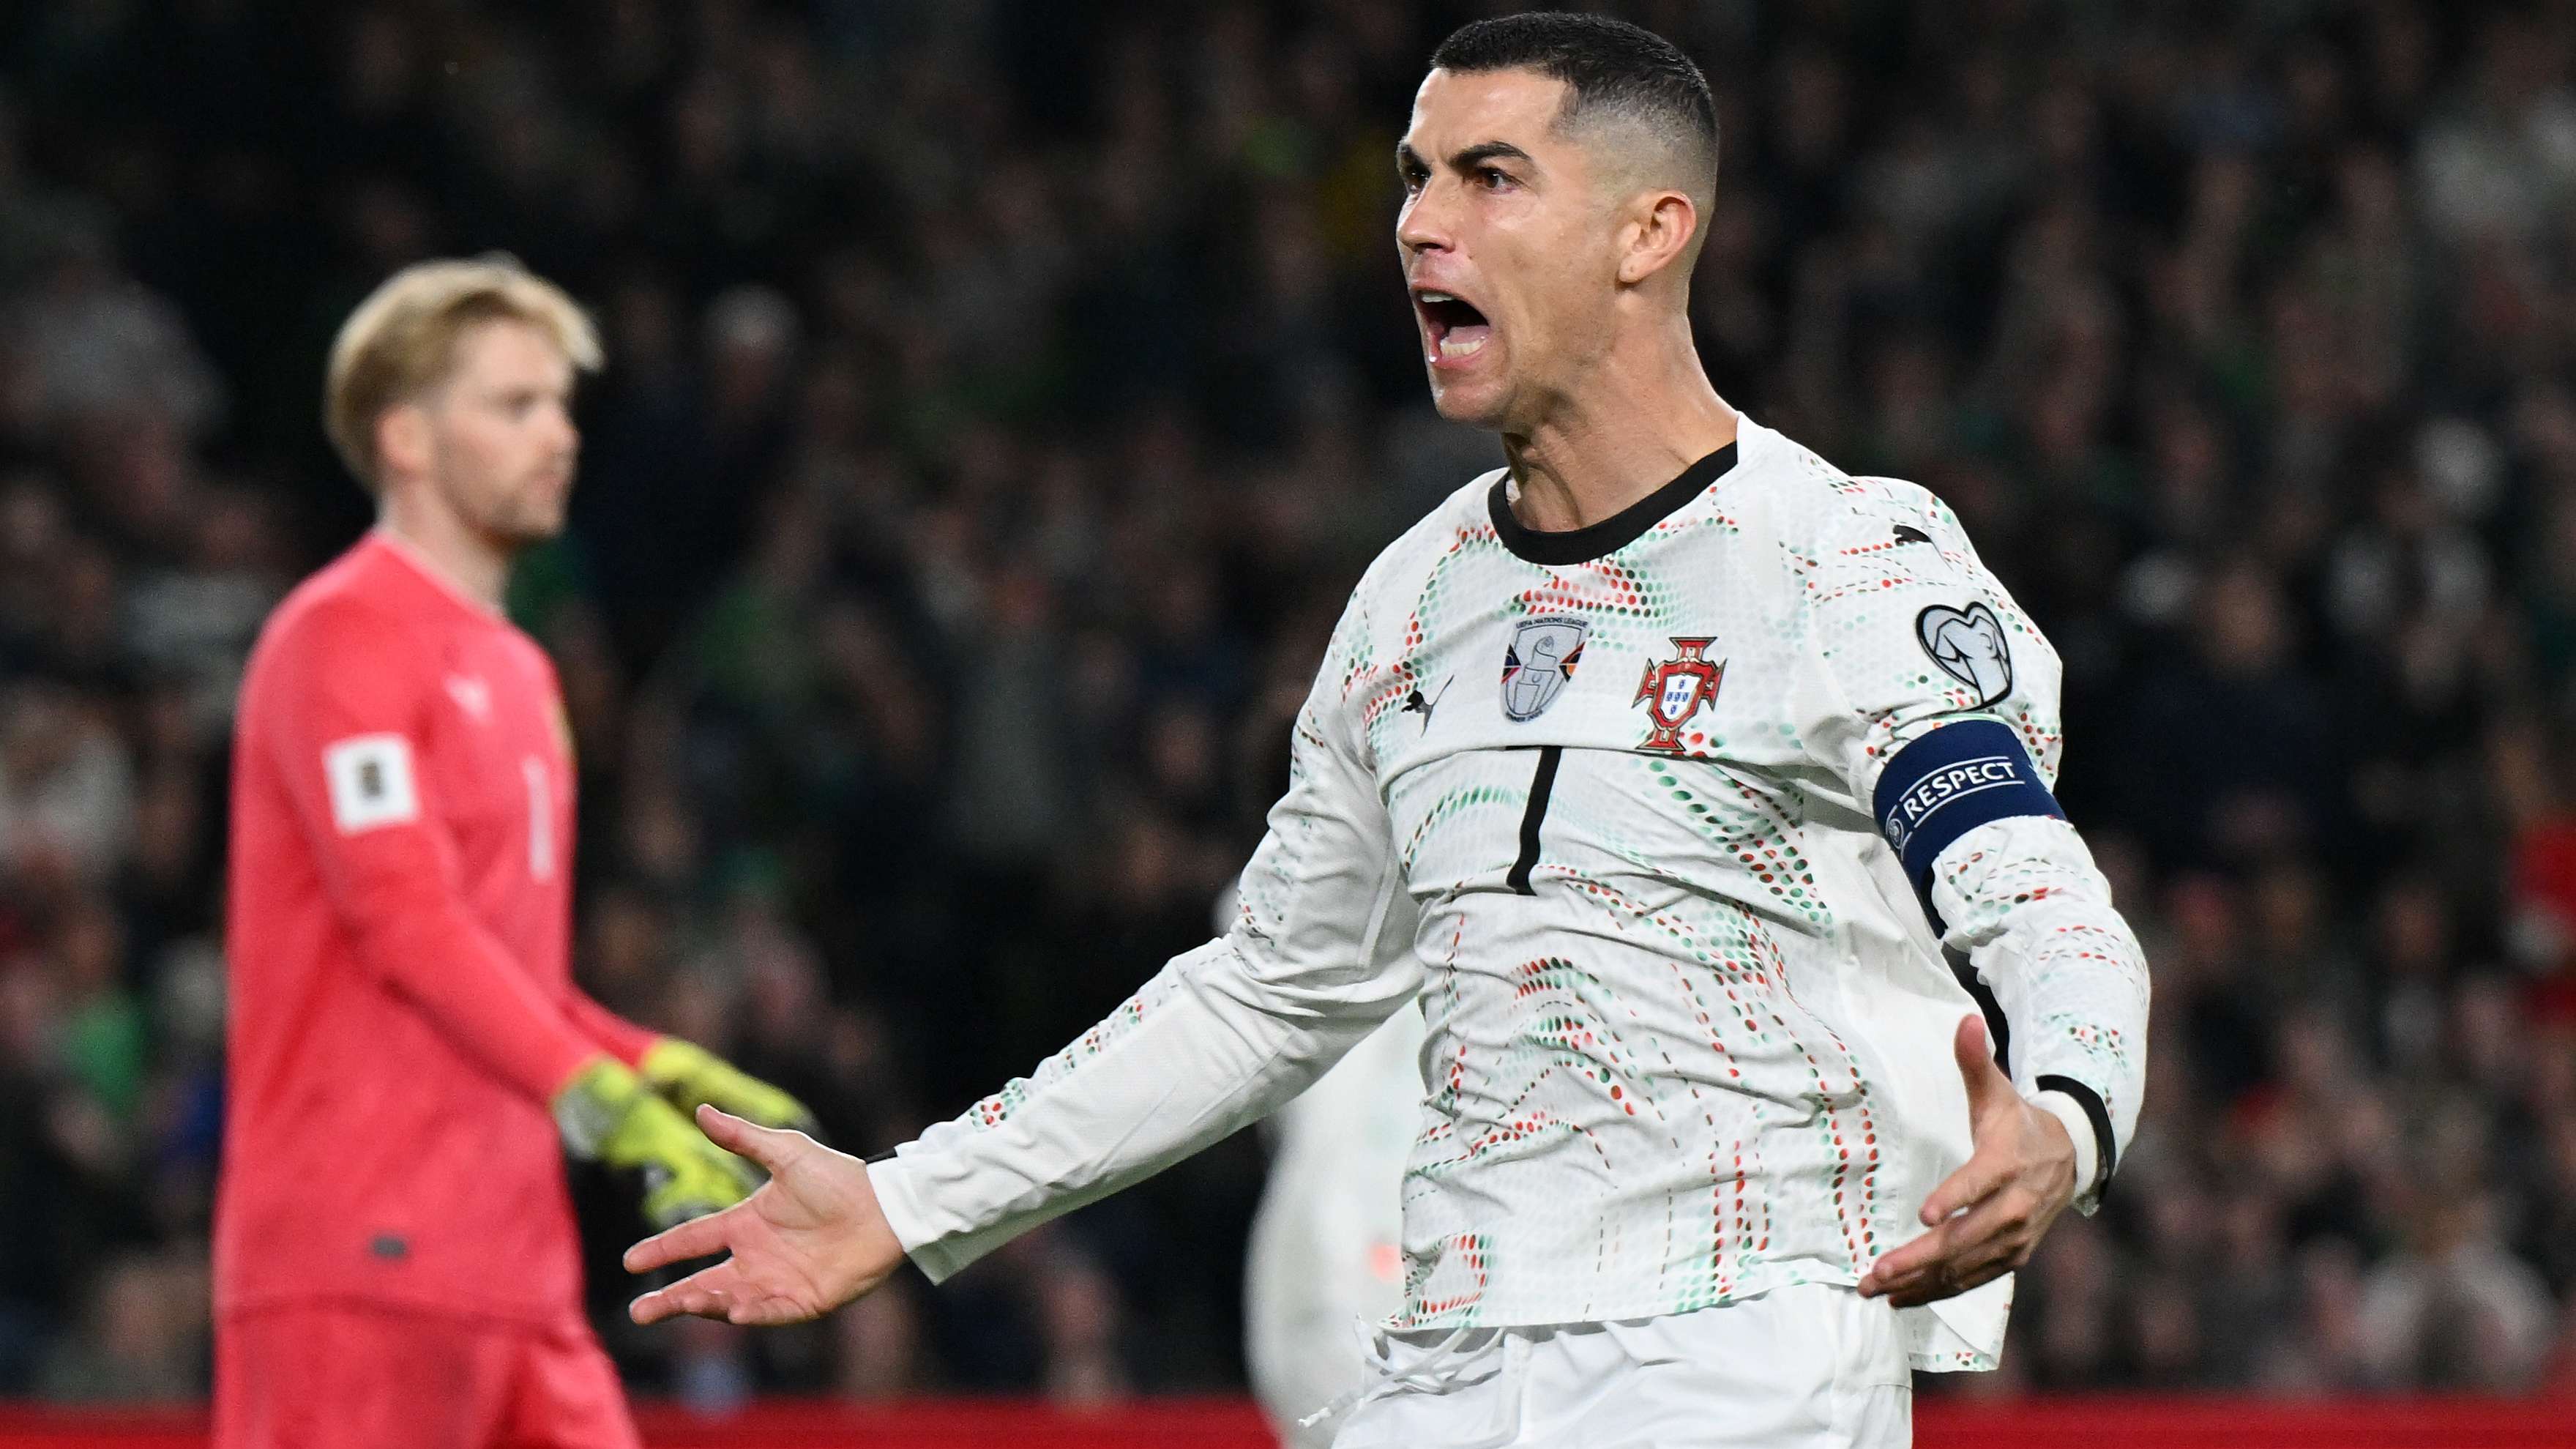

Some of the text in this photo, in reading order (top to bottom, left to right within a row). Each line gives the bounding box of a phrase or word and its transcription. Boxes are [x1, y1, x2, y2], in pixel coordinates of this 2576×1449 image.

[1516, 617, 1588, 629] UEFA NATIONS LEAGUE
[523, 756, 554, 883] 1
[1505, 745, 1564, 896] 7
[1903, 762, 2015, 821] RESPECT
